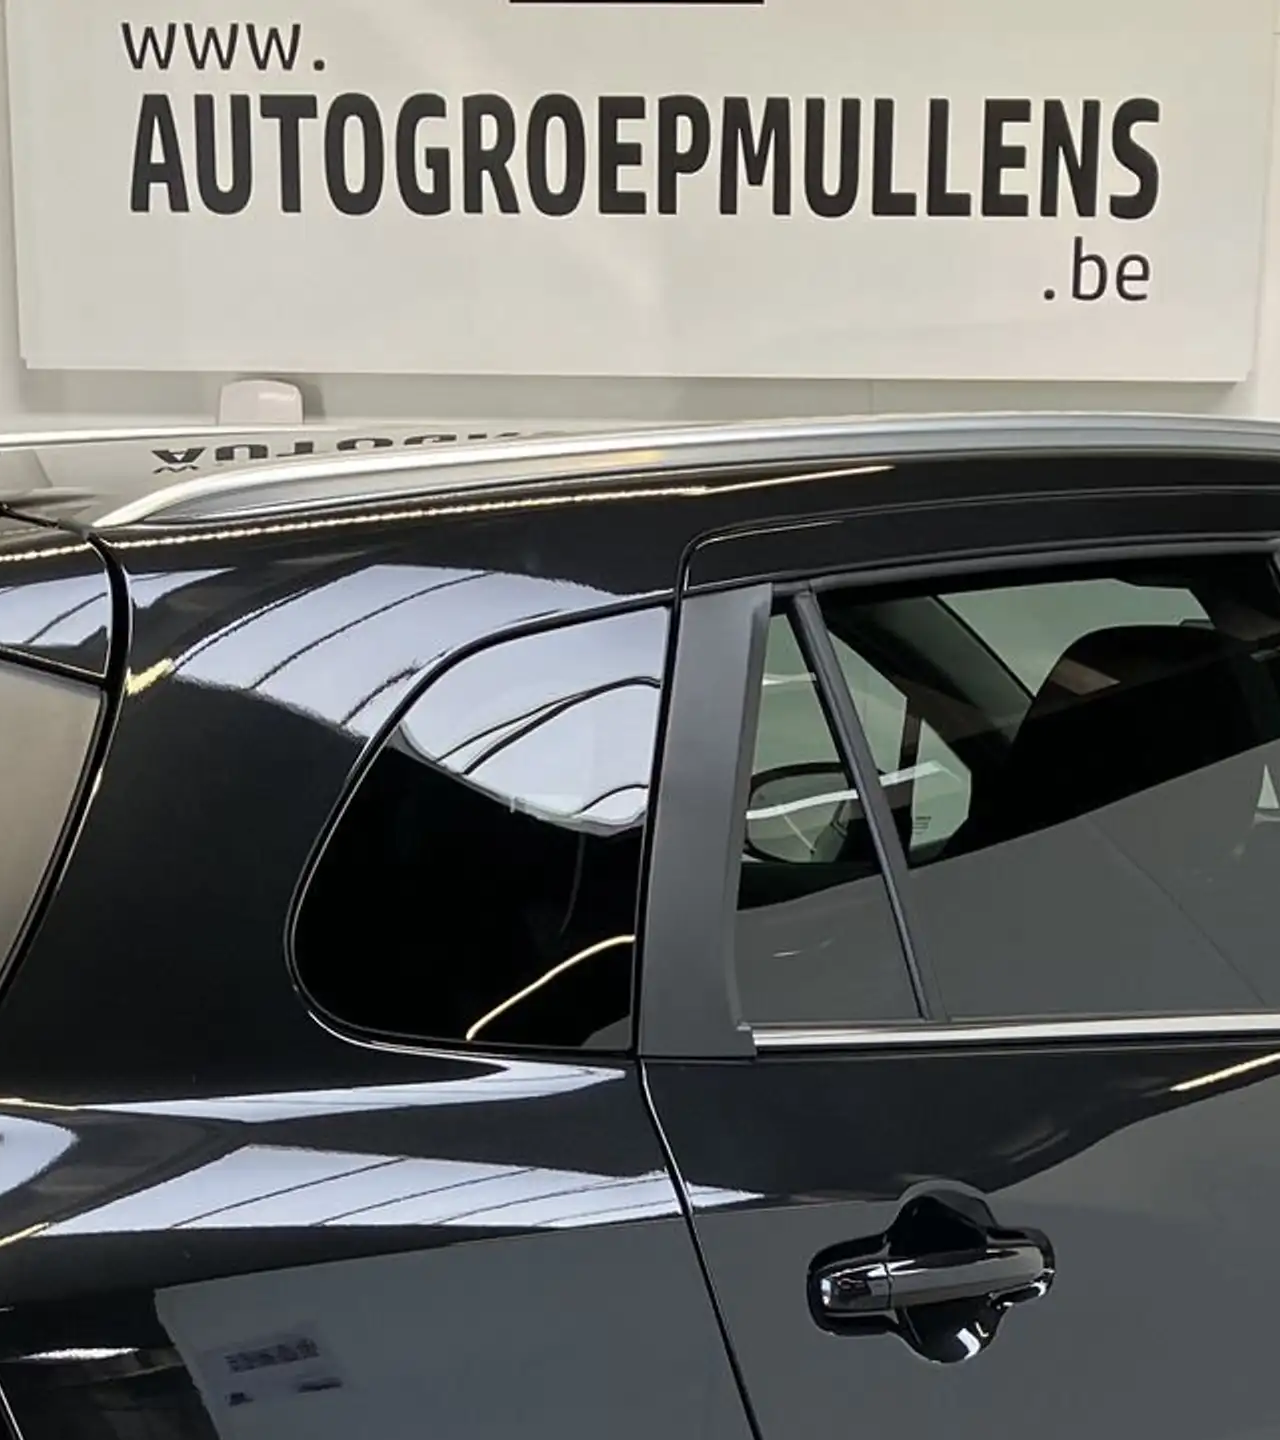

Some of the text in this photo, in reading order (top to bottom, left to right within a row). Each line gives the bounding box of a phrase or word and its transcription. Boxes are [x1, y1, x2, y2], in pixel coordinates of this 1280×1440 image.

[122, 23, 324, 70] www.
[131, 94, 1159, 219] AUTOGROEPMULLENS
[1045, 237, 1148, 300] .be
